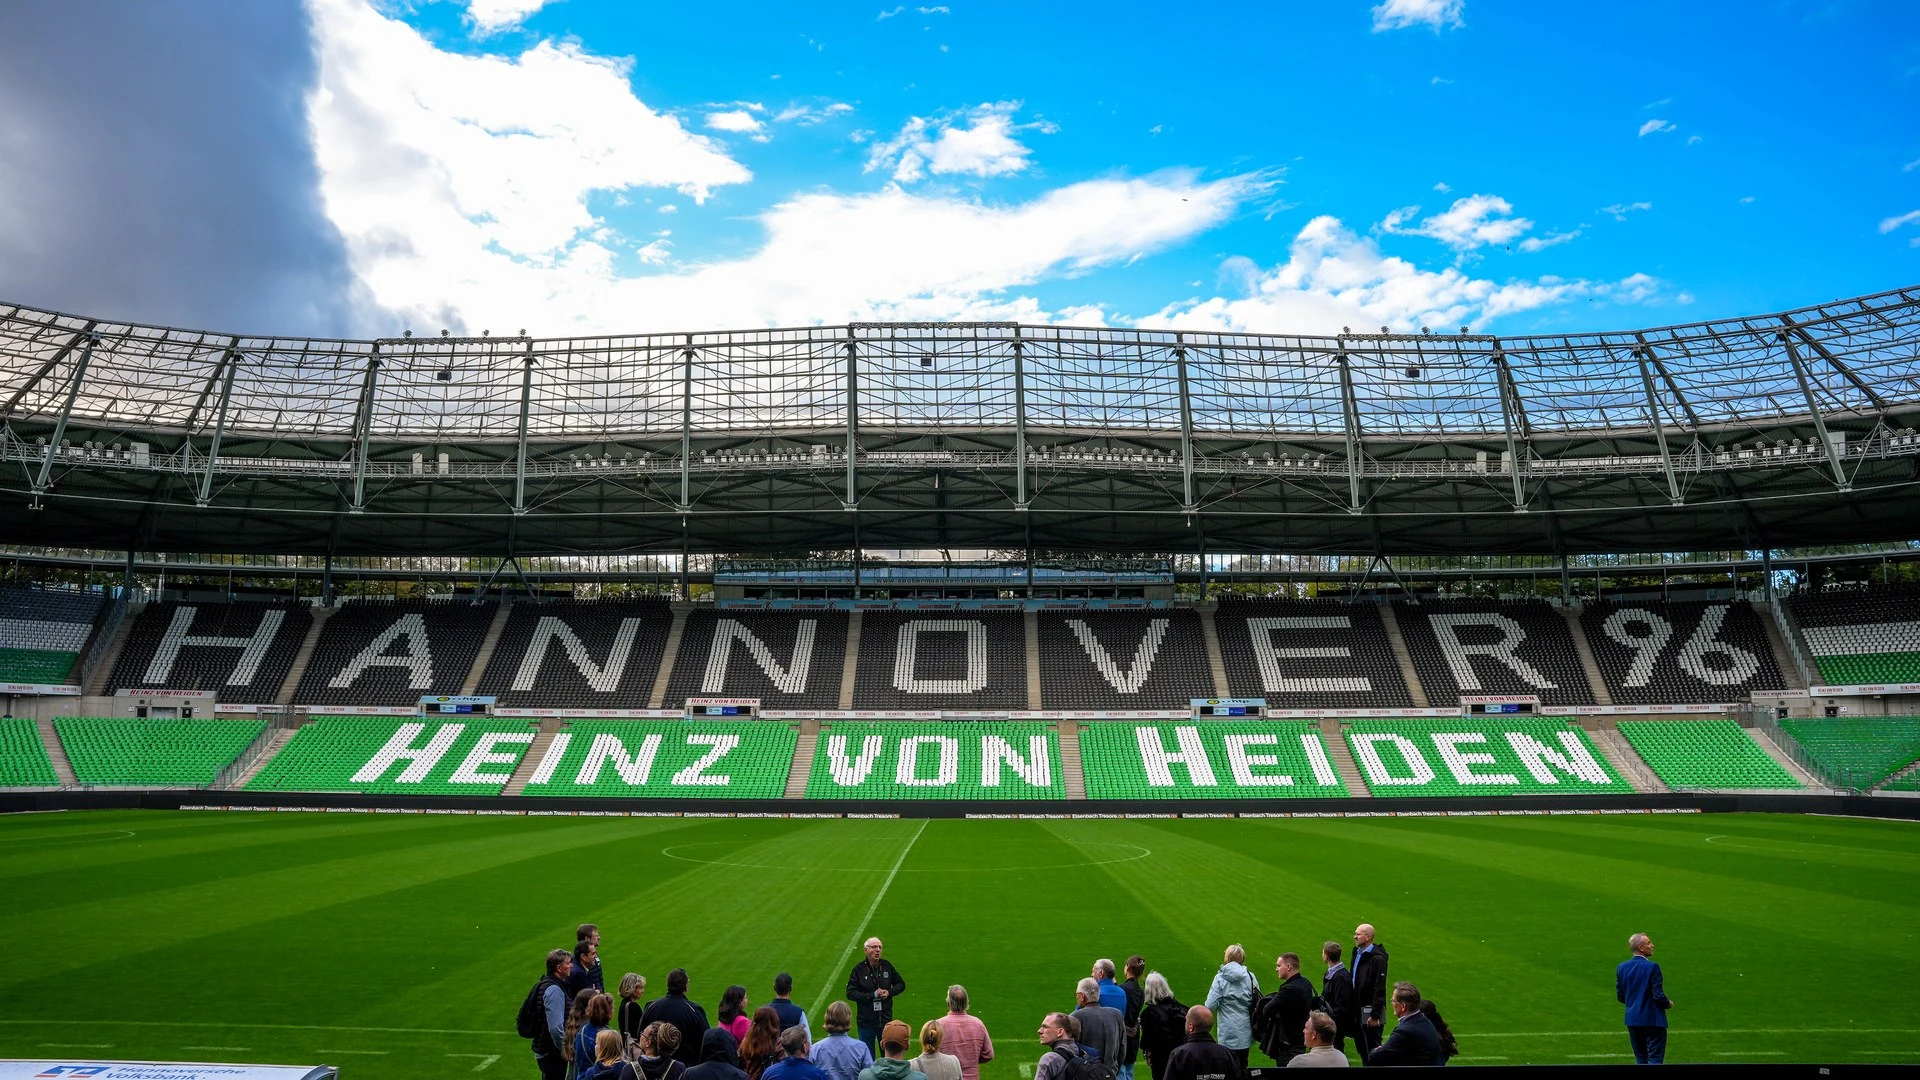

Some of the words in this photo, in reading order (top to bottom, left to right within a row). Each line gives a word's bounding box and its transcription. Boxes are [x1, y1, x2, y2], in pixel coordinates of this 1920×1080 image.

[142, 606, 1557, 693] HANNOVER
[1603, 604, 1760, 688] 96
[350, 722, 739, 786] HEINZ
[827, 734, 1051, 788] VON
[1136, 725, 1611, 787] HEIDEN
[106, 1072, 198, 1080] Volksbank
[117, 1066, 246, 1075] Hannoversche
